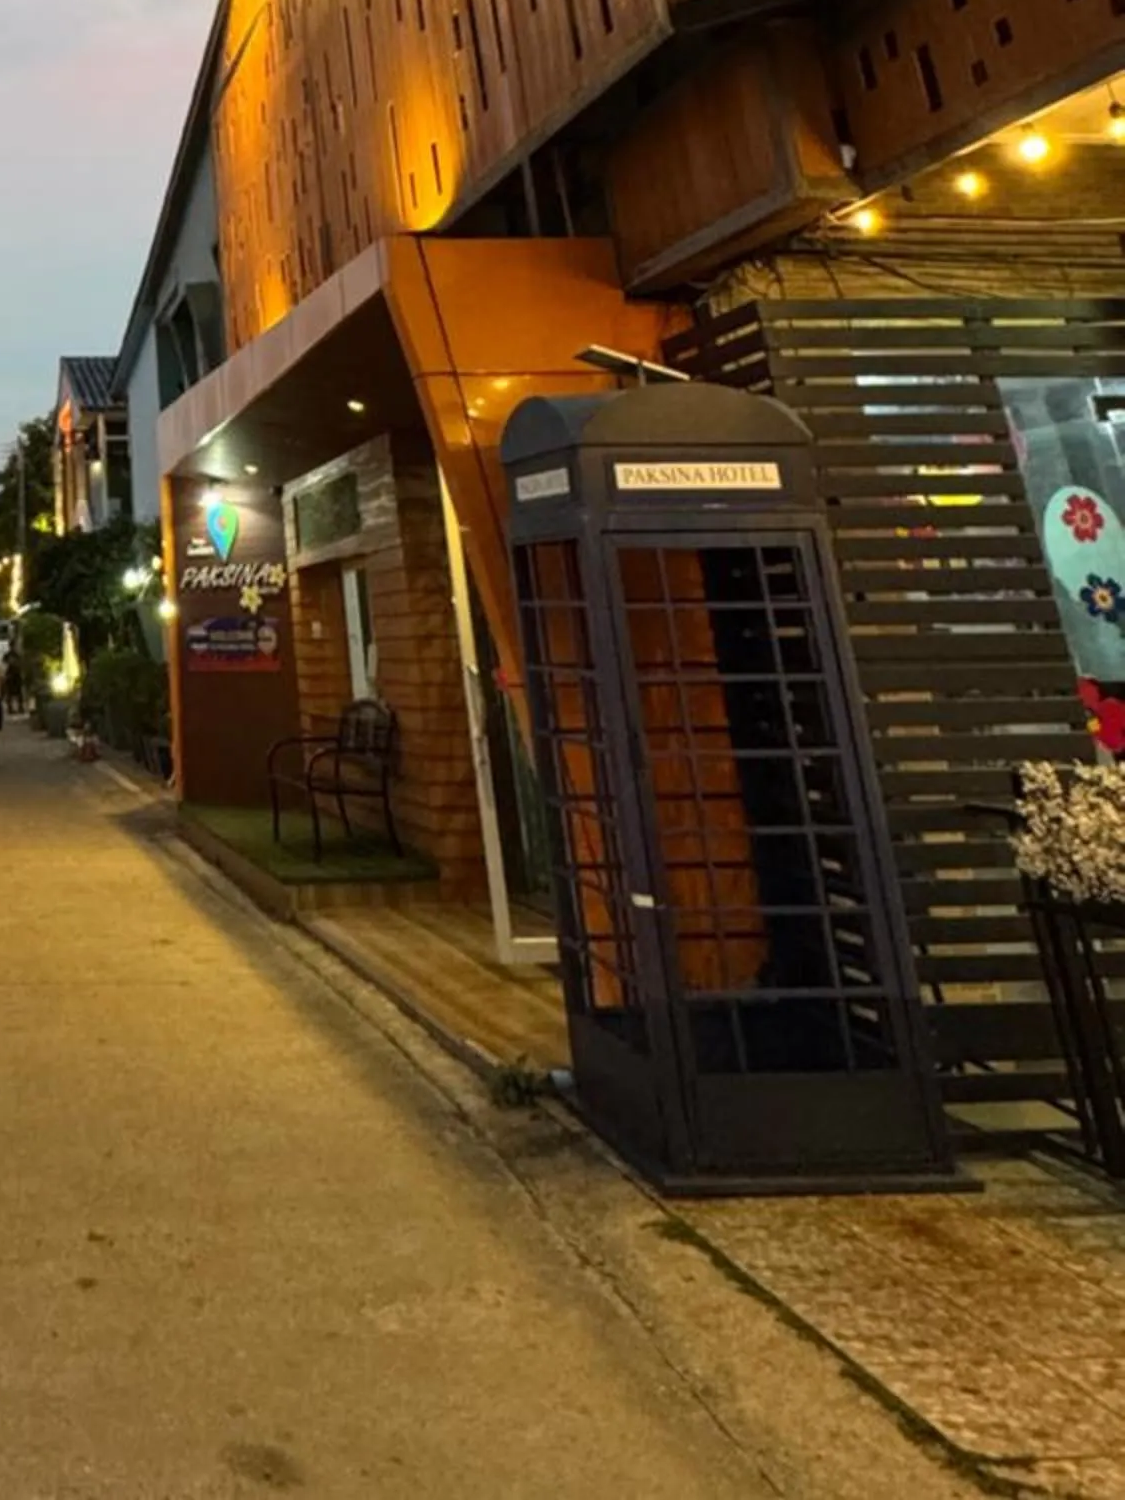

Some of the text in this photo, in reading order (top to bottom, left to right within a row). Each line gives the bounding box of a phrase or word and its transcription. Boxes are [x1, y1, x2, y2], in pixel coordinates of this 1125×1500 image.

[622, 465, 776, 484] PAKSINA HOTEL
[180, 562, 271, 589] PAKSINA
